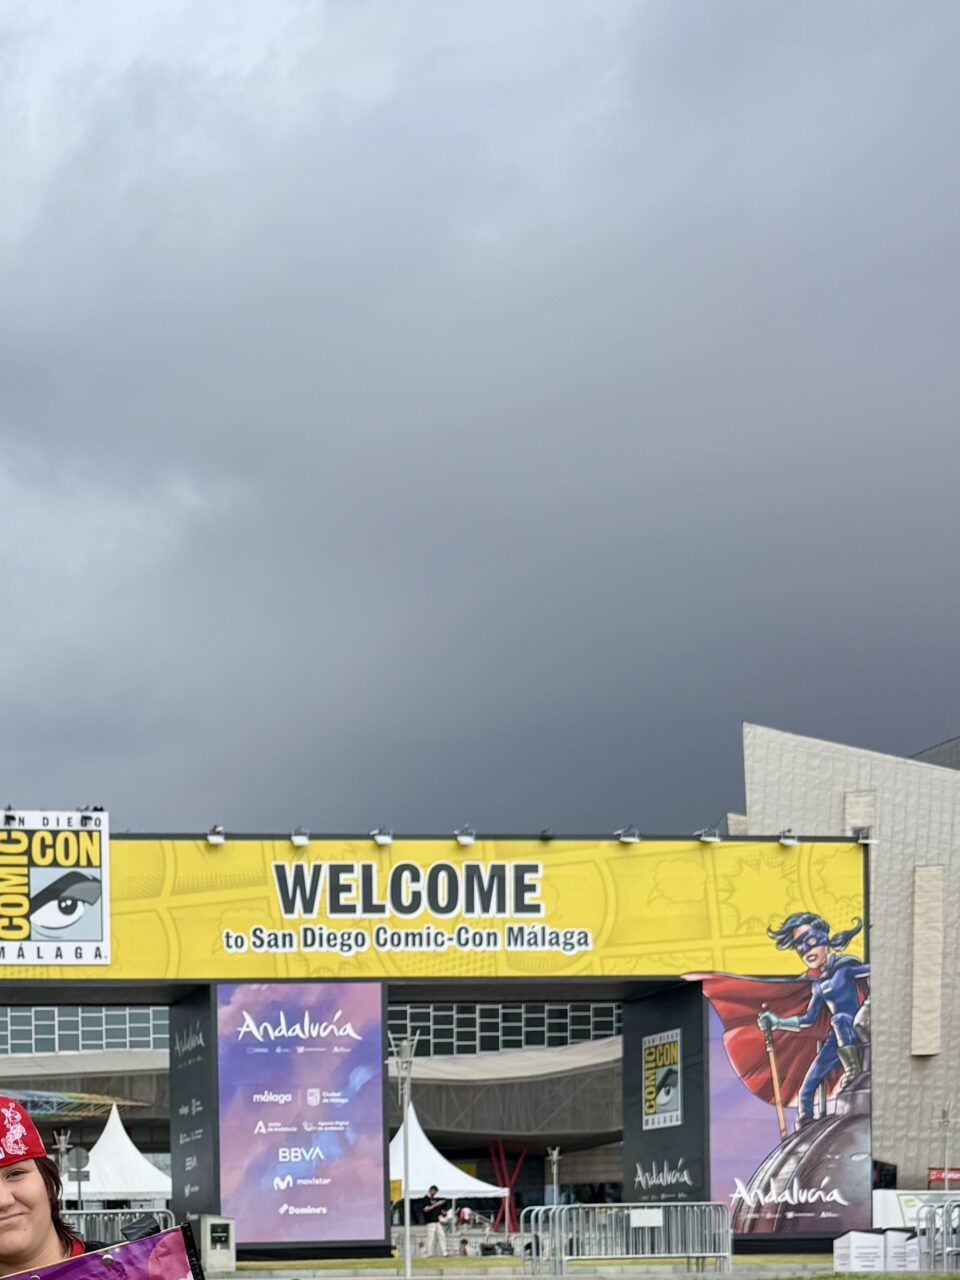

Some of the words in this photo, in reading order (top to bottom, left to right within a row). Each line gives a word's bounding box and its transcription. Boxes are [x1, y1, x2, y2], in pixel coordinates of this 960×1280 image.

[31, 830, 101, 867] CON
[273, 863, 541, 915] WELCOME
[224, 931, 245, 949] to
[251, 927, 294, 949] San
[303, 926, 366, 952] Diego
[375, 926, 498, 948] Comic-Con
[506, 925, 589, 951] Málaga
[236, 1009, 362, 1042] Andalucía
[656, 1041, 678, 1066] CON
[644, 1047, 656, 1114] COMIC
[253, 1091, 292, 1104] málaga
[279, 1146, 324, 1162] BBVA
[296, 1177, 331, 1185] movistar
[634, 1158, 692, 1189] Andalucía
[729, 1176, 849, 1207] Andalucía
